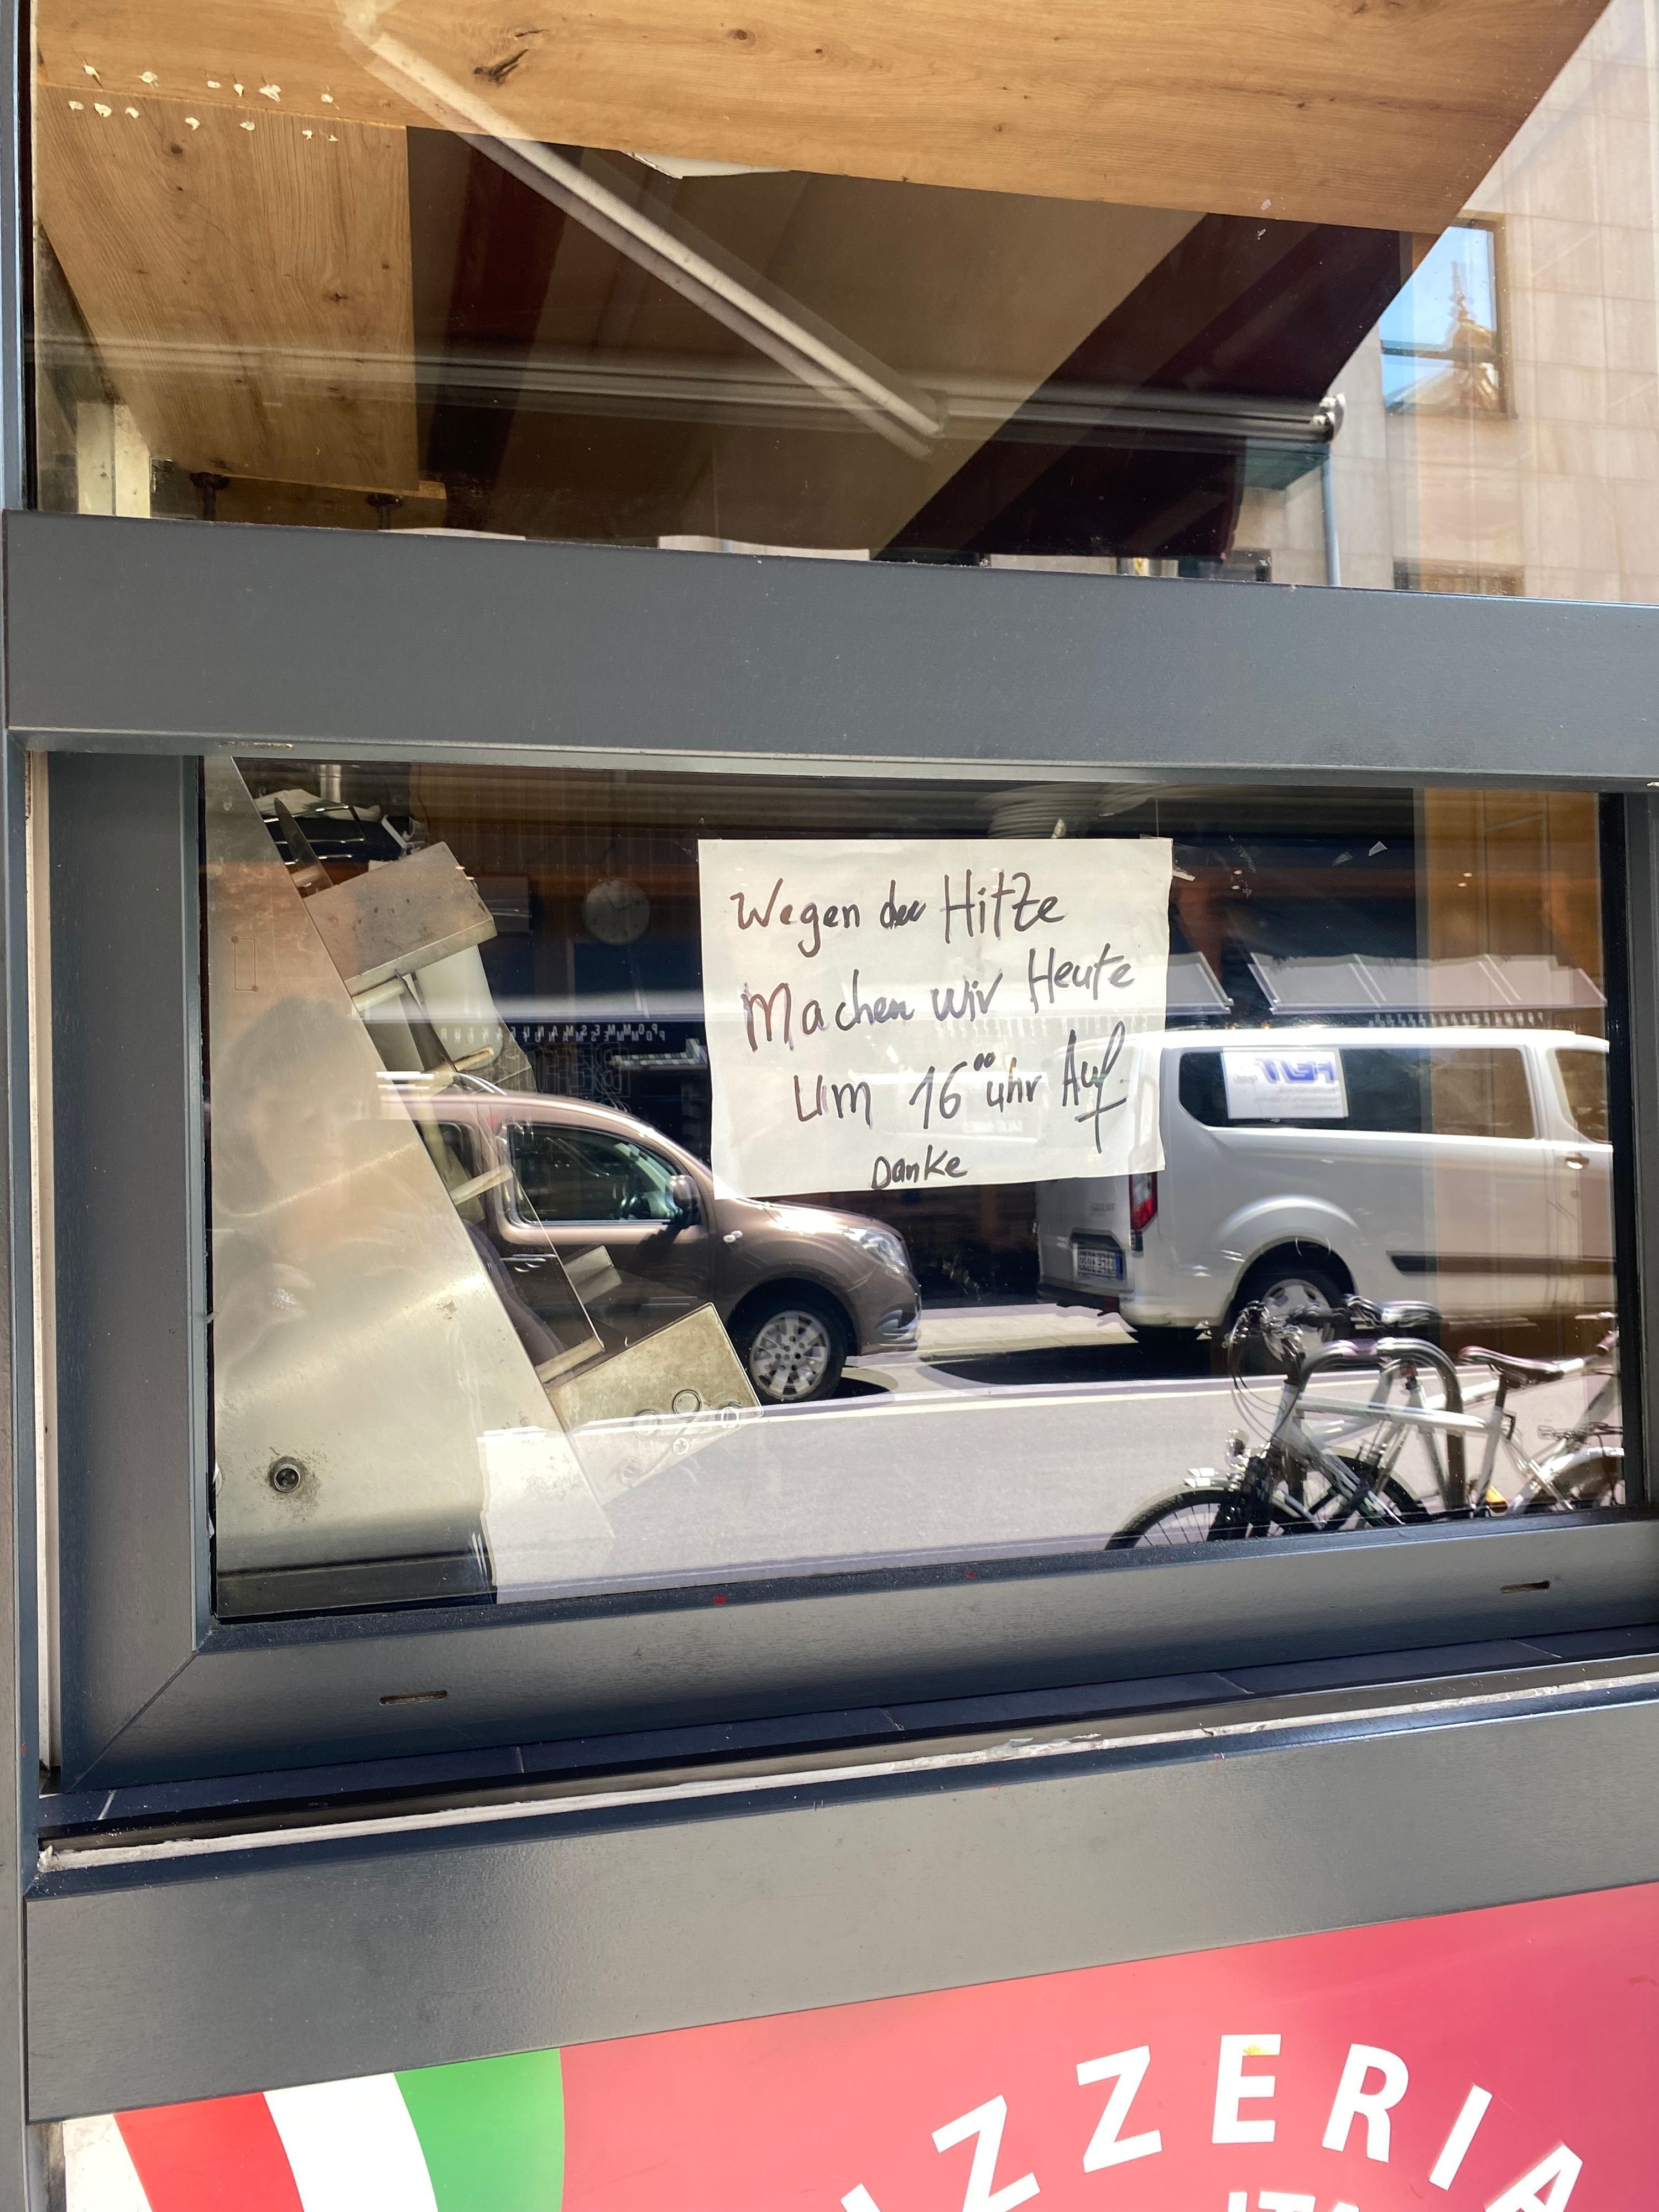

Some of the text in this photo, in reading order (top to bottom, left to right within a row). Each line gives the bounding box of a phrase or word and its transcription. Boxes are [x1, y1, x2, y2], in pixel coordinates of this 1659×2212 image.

[730, 878, 859, 957] Wegen
[940, 869, 1065, 945] Hitze
[740, 969, 915, 1052] Machen
[1029, 943, 1135, 1014] Heute
[1062, 1020, 1127, 1154] Auf
[871, 1144, 969, 1190] Danke
